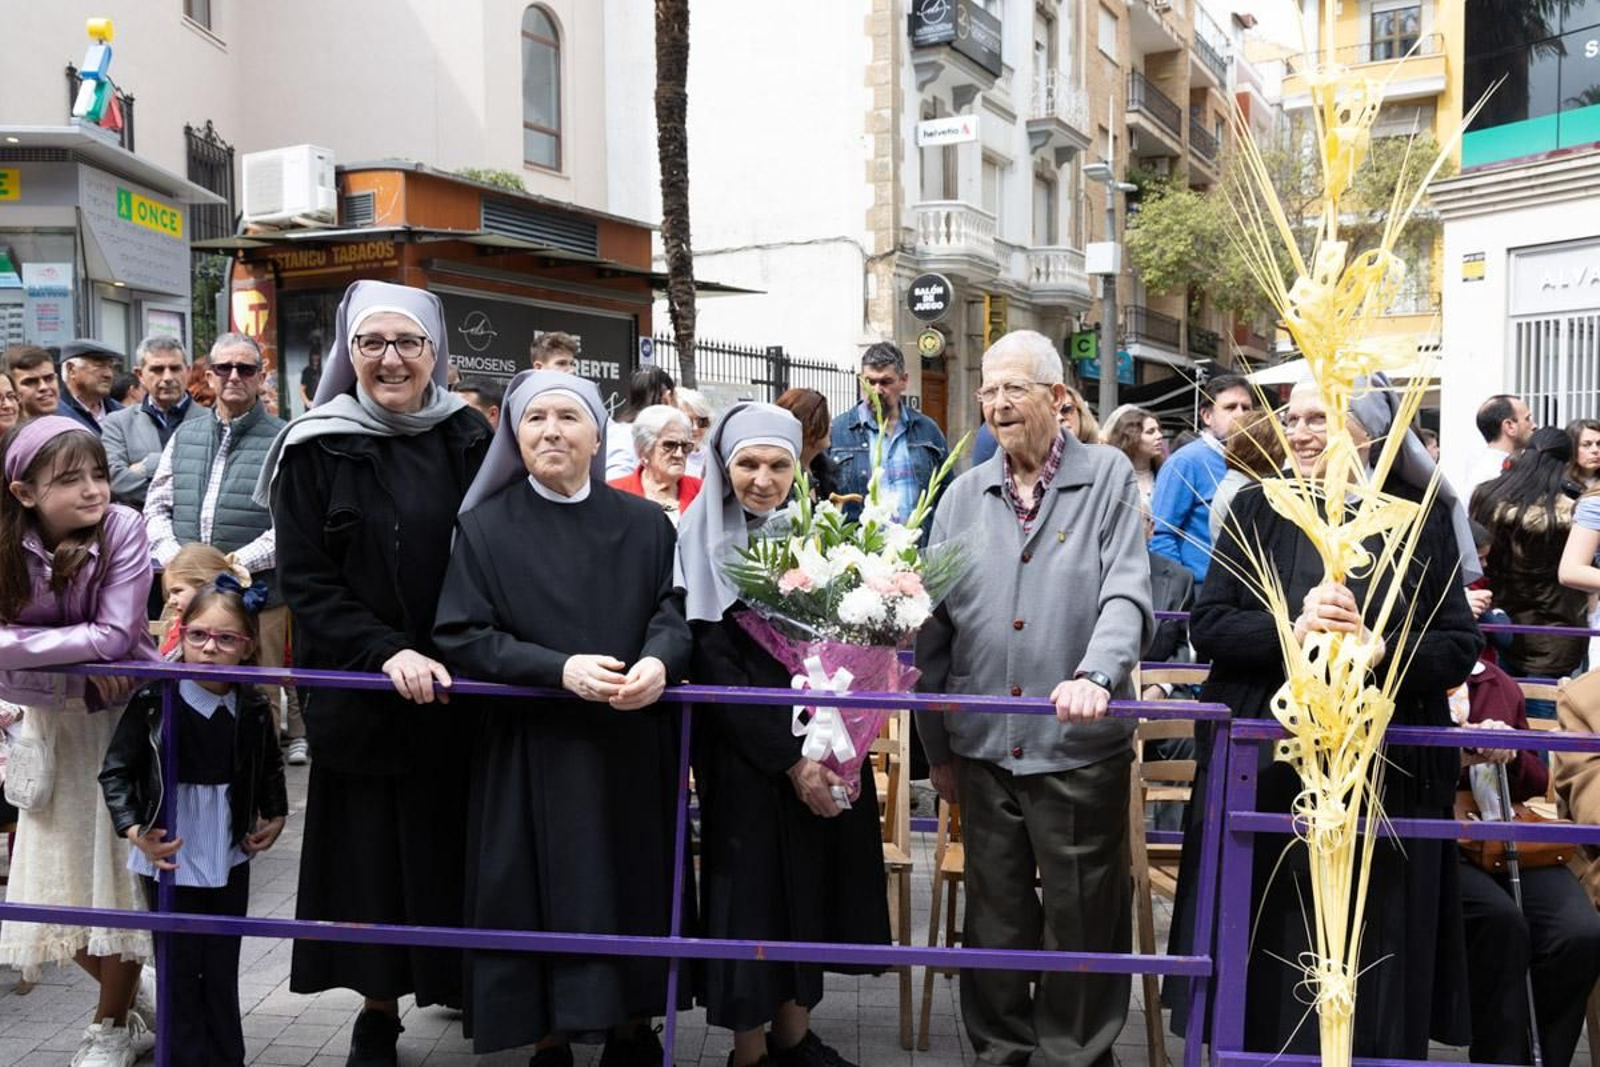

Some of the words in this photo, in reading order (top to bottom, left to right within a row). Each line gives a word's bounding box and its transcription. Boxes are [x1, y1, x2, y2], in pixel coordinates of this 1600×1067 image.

[137, 201, 178, 232] ONCE
[331, 240, 395, 264] TABACOS
[914, 284, 944, 296] SALÓN
[914, 301, 944, 311] JUEGO
[922, 295, 935, 303] DE
[1077, 339, 1090, 353] C
[448, 355, 516, 373] ERMOSENS
[574, 358, 620, 379] RERTE
